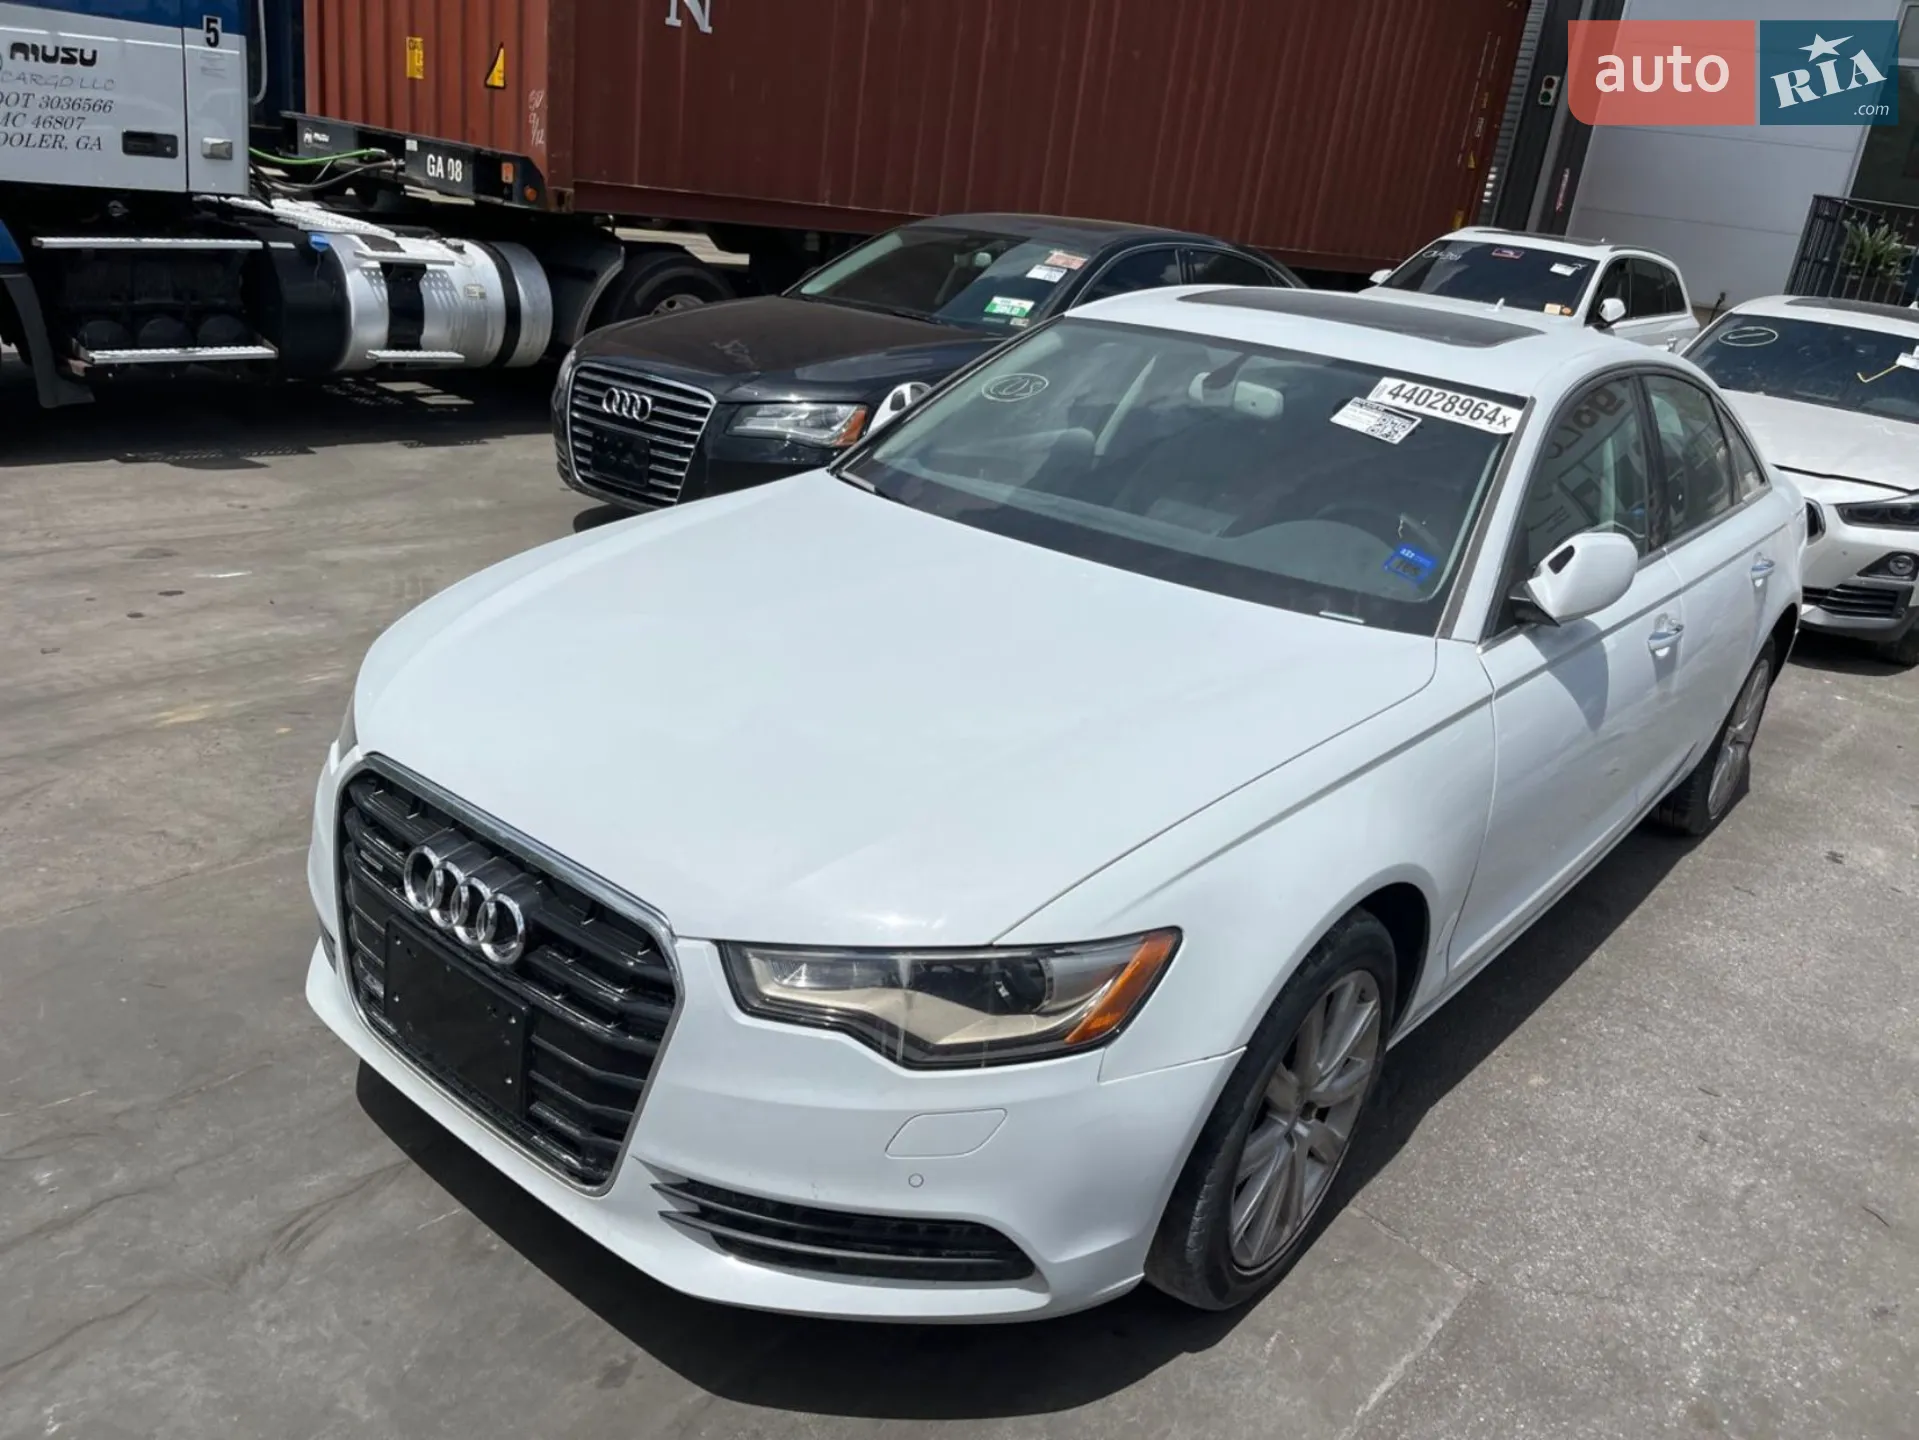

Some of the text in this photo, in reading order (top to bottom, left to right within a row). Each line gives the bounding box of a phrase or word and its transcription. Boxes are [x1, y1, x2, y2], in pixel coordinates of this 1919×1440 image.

[205, 18, 220, 48] 5
[38, 94, 115, 114] 3036566
[31, 115, 87, 131] 46807
[75, 135, 103, 151] GA
[427, 153, 463, 182] GA 08
